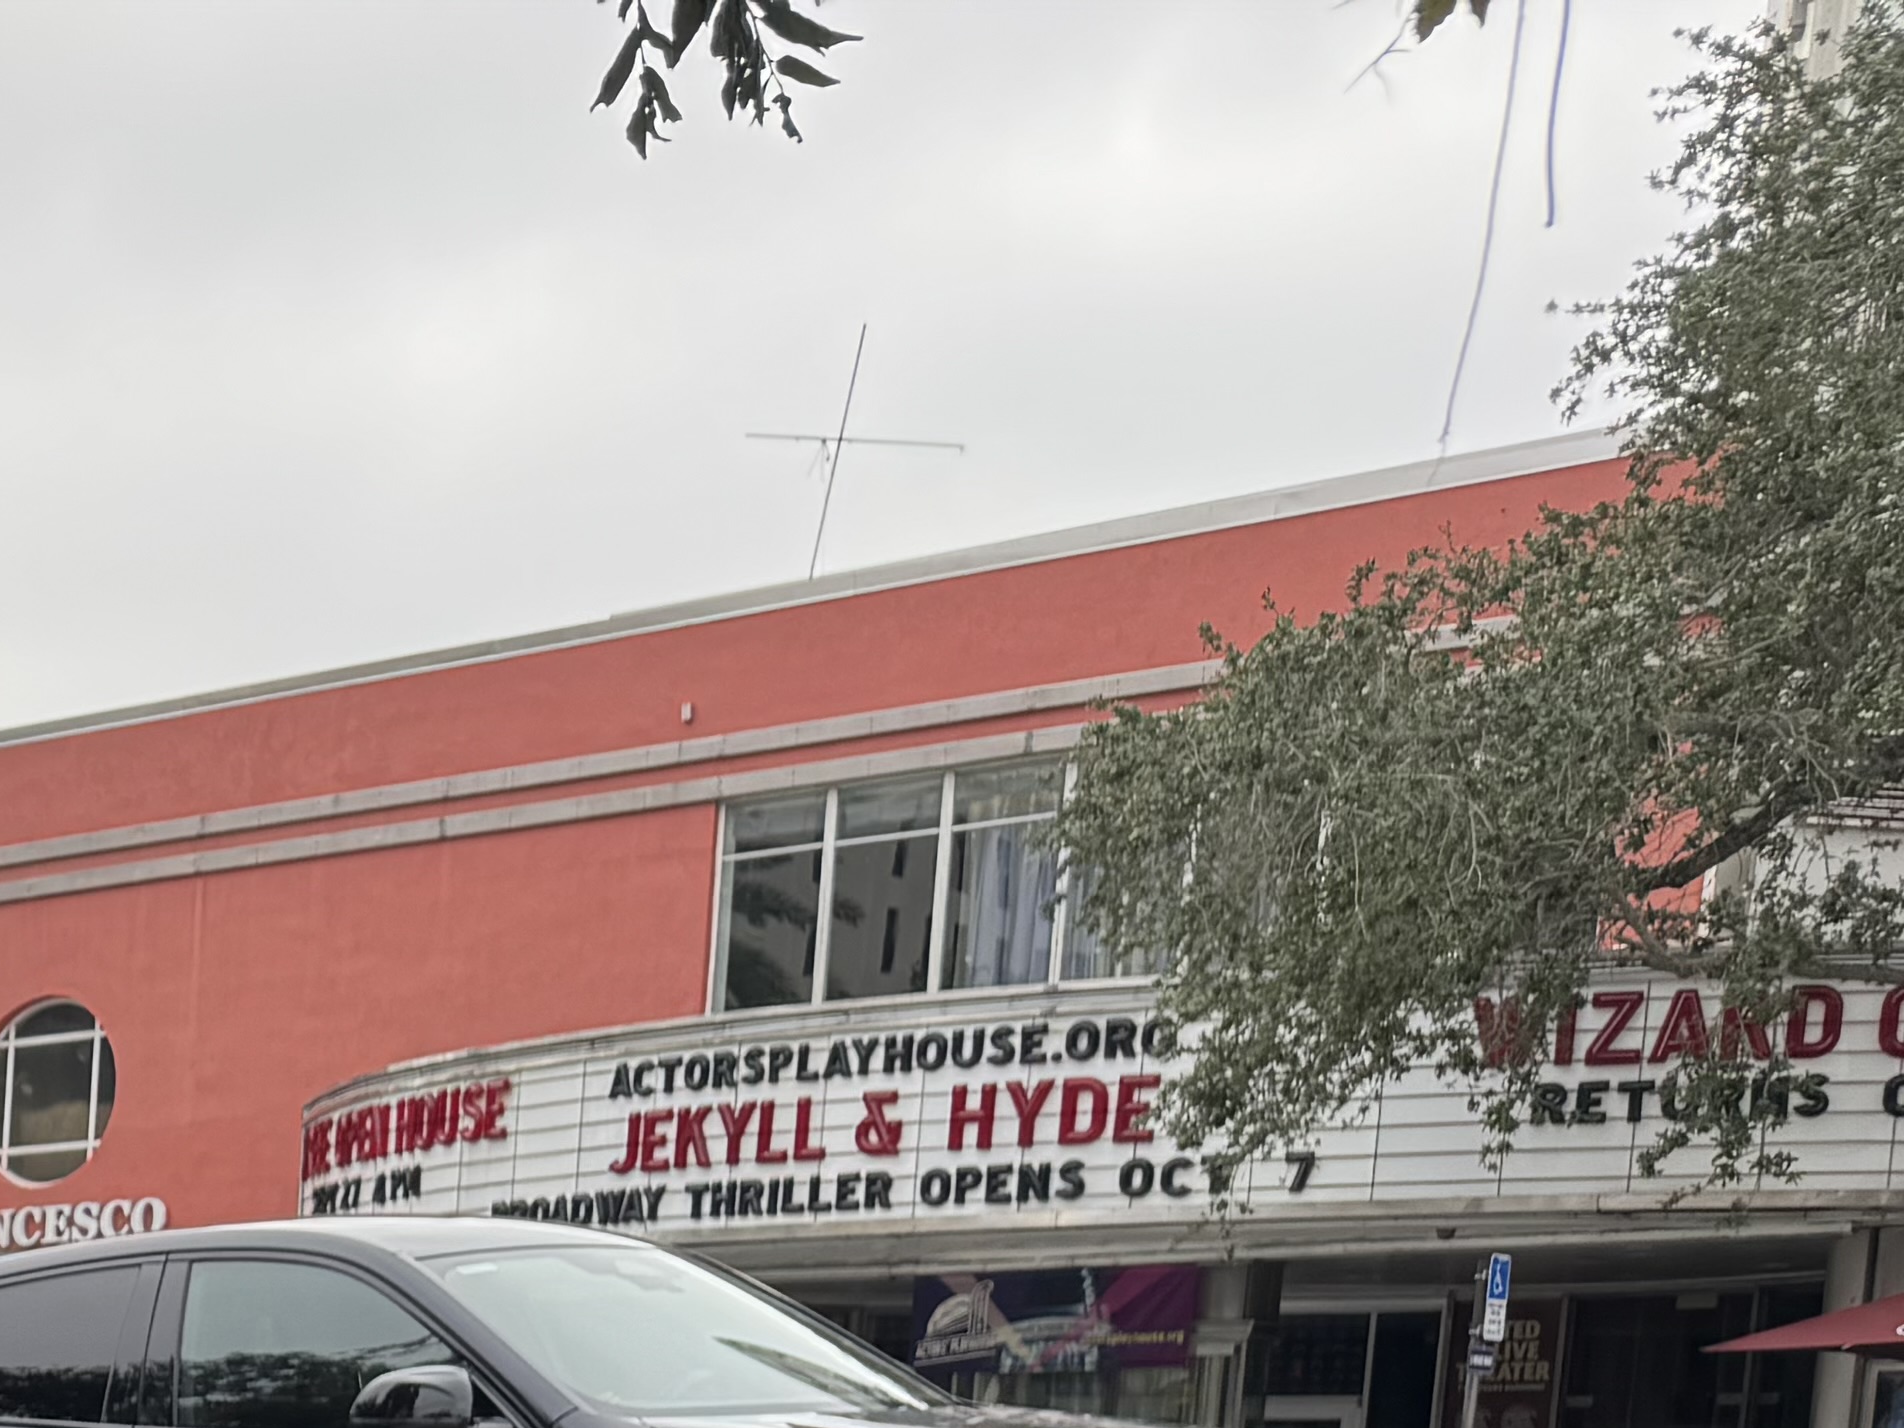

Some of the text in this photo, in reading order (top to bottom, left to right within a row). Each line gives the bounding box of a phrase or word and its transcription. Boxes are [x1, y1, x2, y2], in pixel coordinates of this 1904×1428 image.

[1473, 984, 1844, 1066] WIZARD
[395, 1077, 512, 1155] HOUSE
[609, 1073, 1162, 1174] JEKYLL & HYDE
[685, 1171, 893, 1220] THRILLER
[920, 1159, 1086, 1206] OPENS
[1119, 1151, 1236, 1198] OCT
[1285, 1151, 1316, 1193] 7
[1456, 1361, 1550, 1382] TATER
